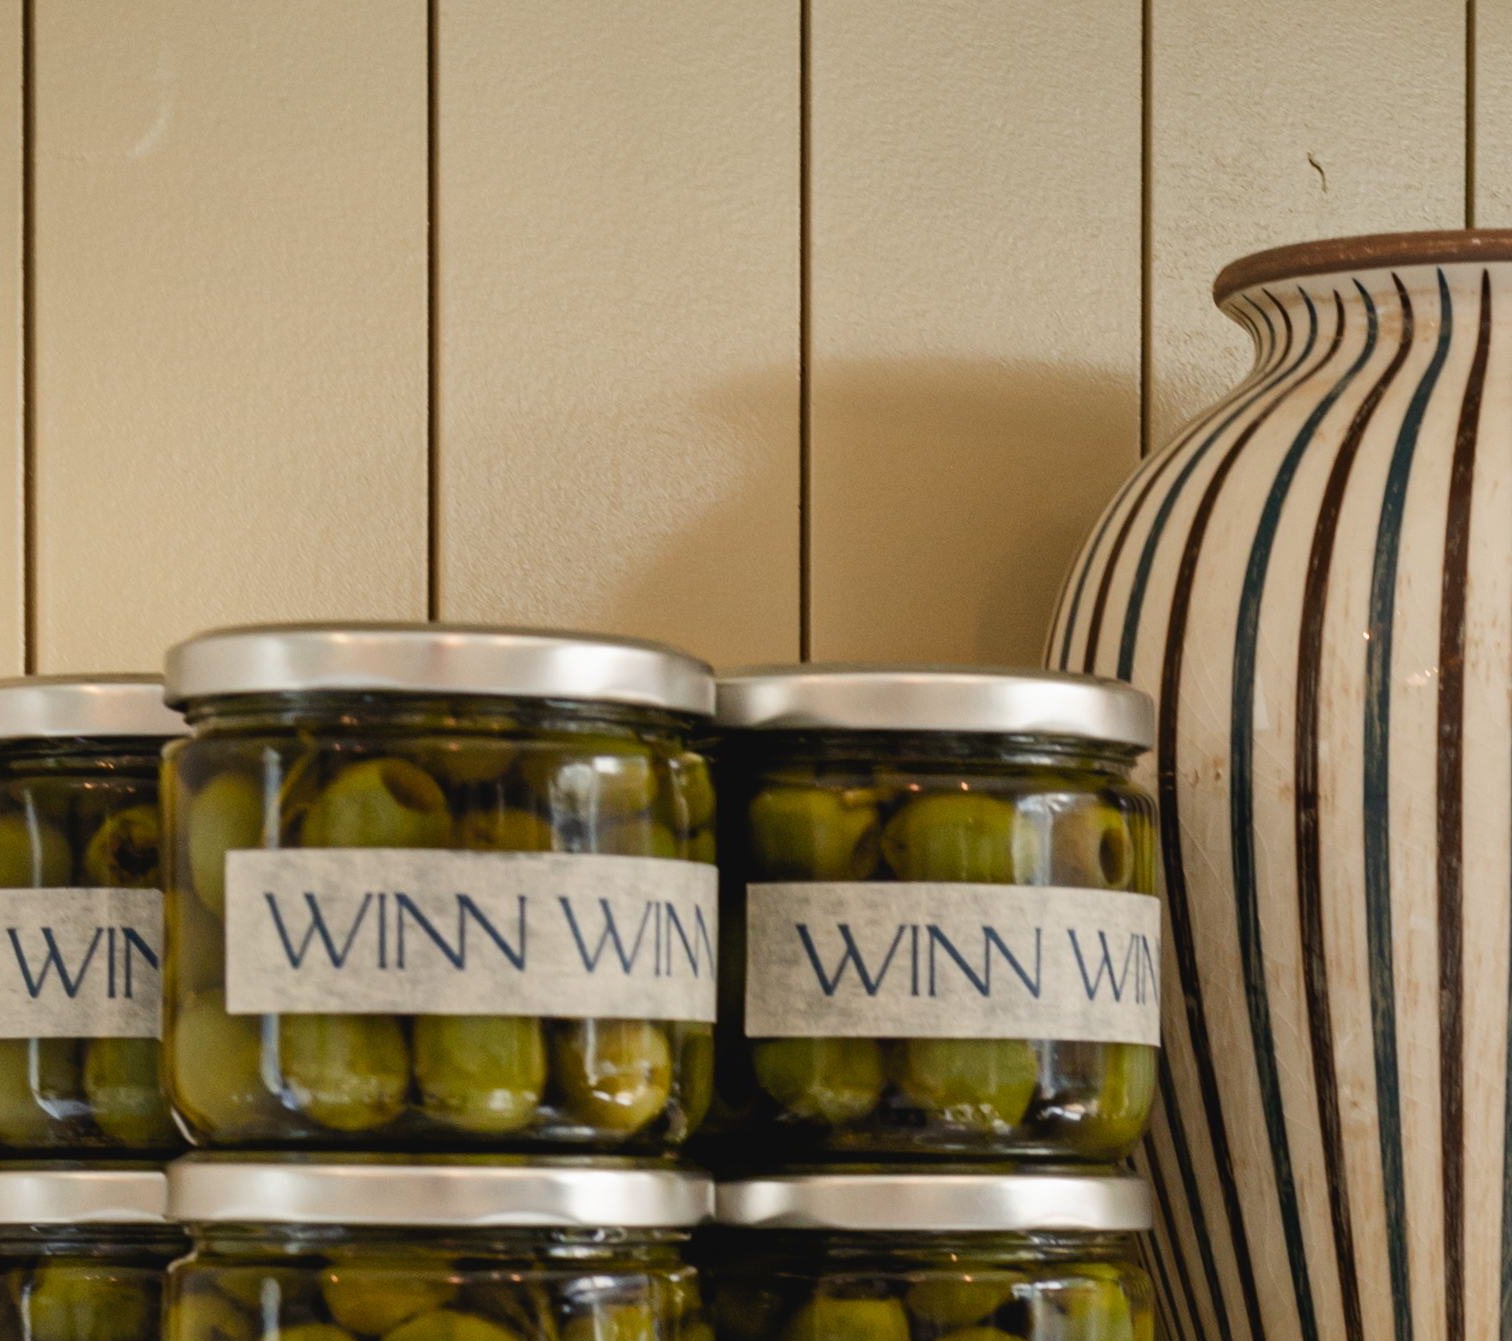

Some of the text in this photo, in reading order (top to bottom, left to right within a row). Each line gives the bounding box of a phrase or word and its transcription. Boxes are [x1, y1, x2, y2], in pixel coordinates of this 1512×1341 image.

[6, 926, 159, 999] WIN
[264, 892, 527, 971] WINN
[795, 924, 1042, 999] WINN
